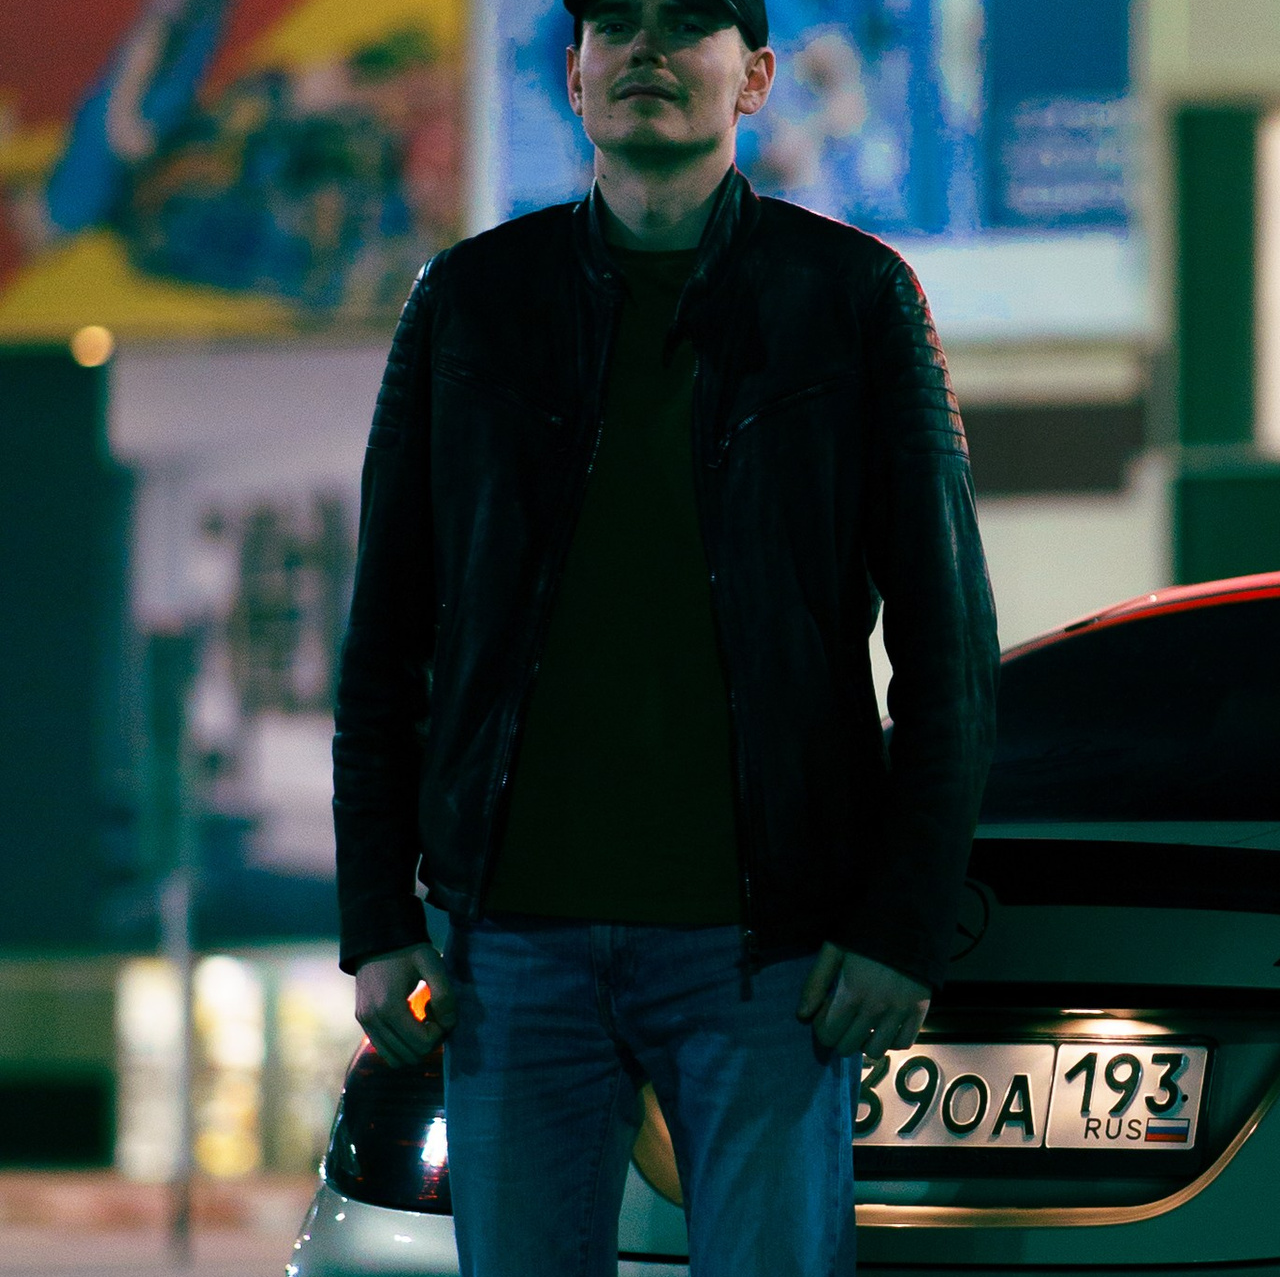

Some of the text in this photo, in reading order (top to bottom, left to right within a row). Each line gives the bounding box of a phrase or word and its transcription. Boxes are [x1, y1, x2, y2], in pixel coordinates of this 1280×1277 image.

[853, 1051, 1183, 1137] 39ОА 193
[1084, 1117, 1142, 1140] RUS
